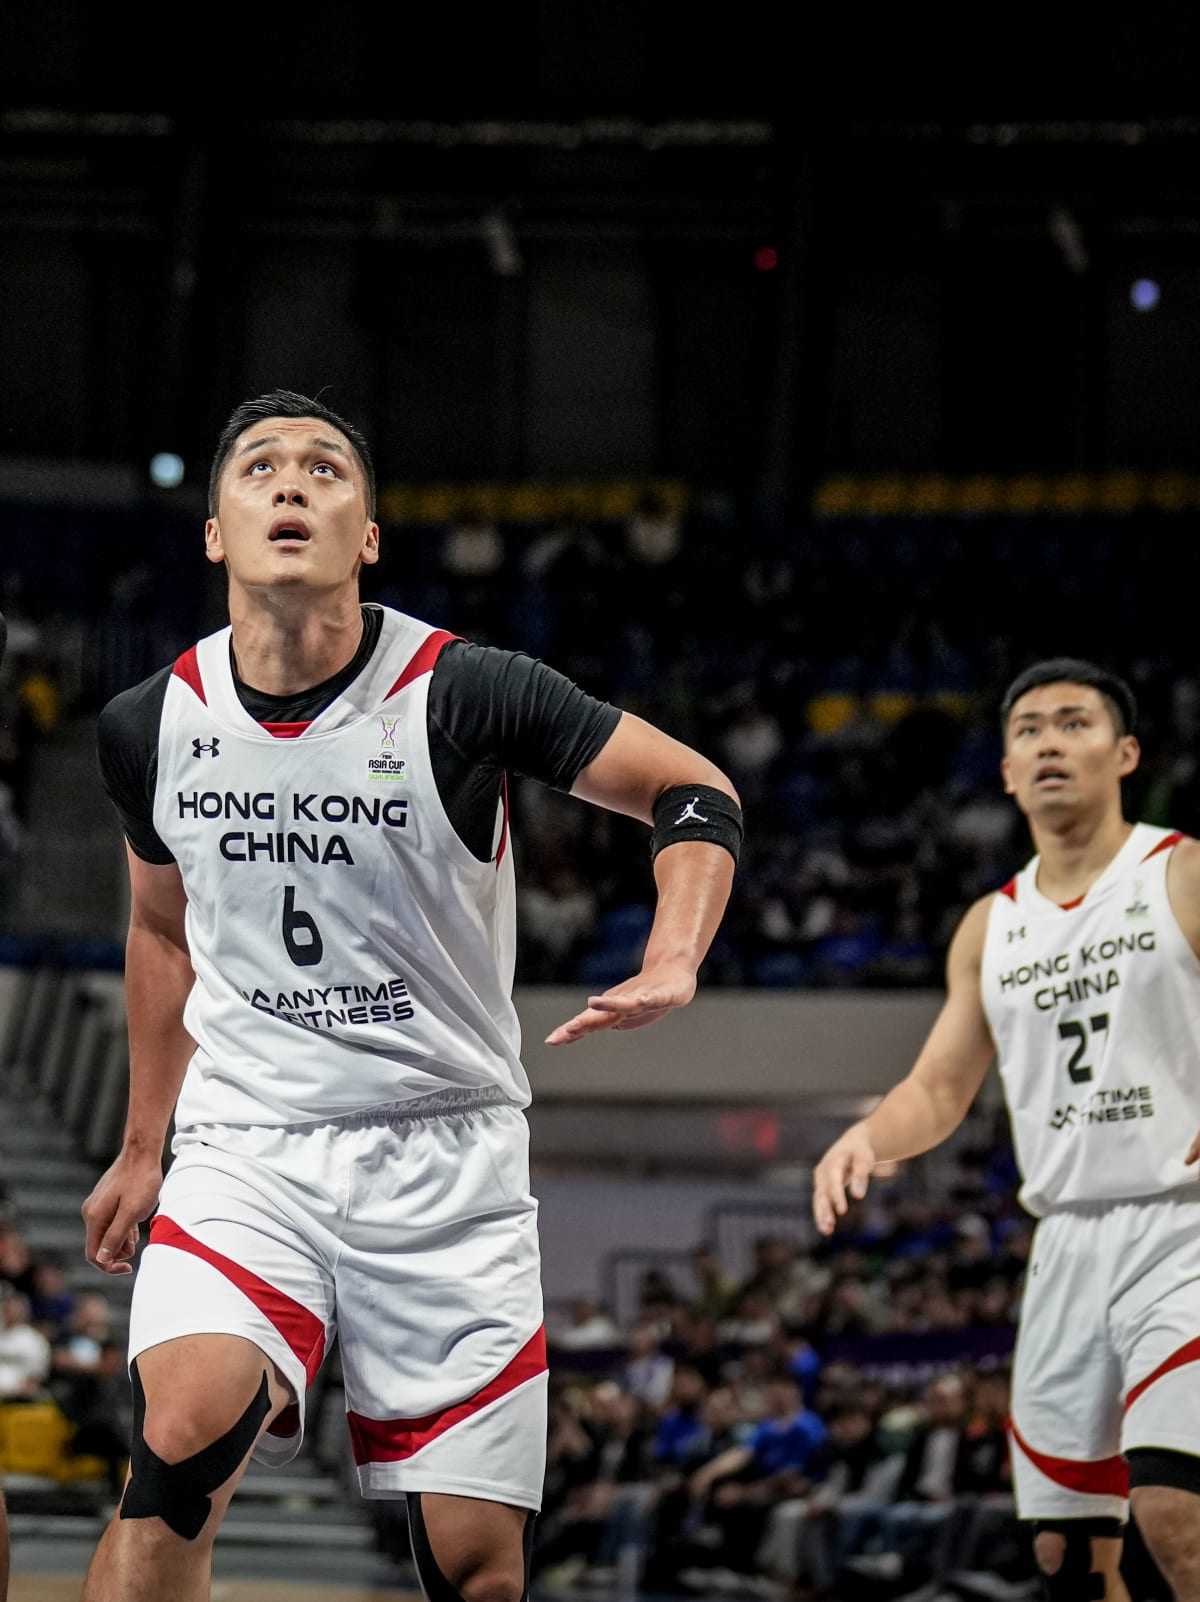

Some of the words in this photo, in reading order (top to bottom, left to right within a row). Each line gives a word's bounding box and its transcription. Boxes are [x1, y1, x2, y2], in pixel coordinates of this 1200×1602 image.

[368, 759, 388, 769] ASIA
[388, 760, 405, 770] CUP
[177, 791, 275, 820] HONG
[293, 793, 409, 828] KONG
[219, 831, 355, 866] CHINA
[282, 885, 324, 967] 6
[1000, 954, 1070, 992] HONG
[1080, 931, 1156, 966] KONG
[276, 978, 409, 1011] ANYTIME
[1034, 968, 1120, 1012] CHINA
